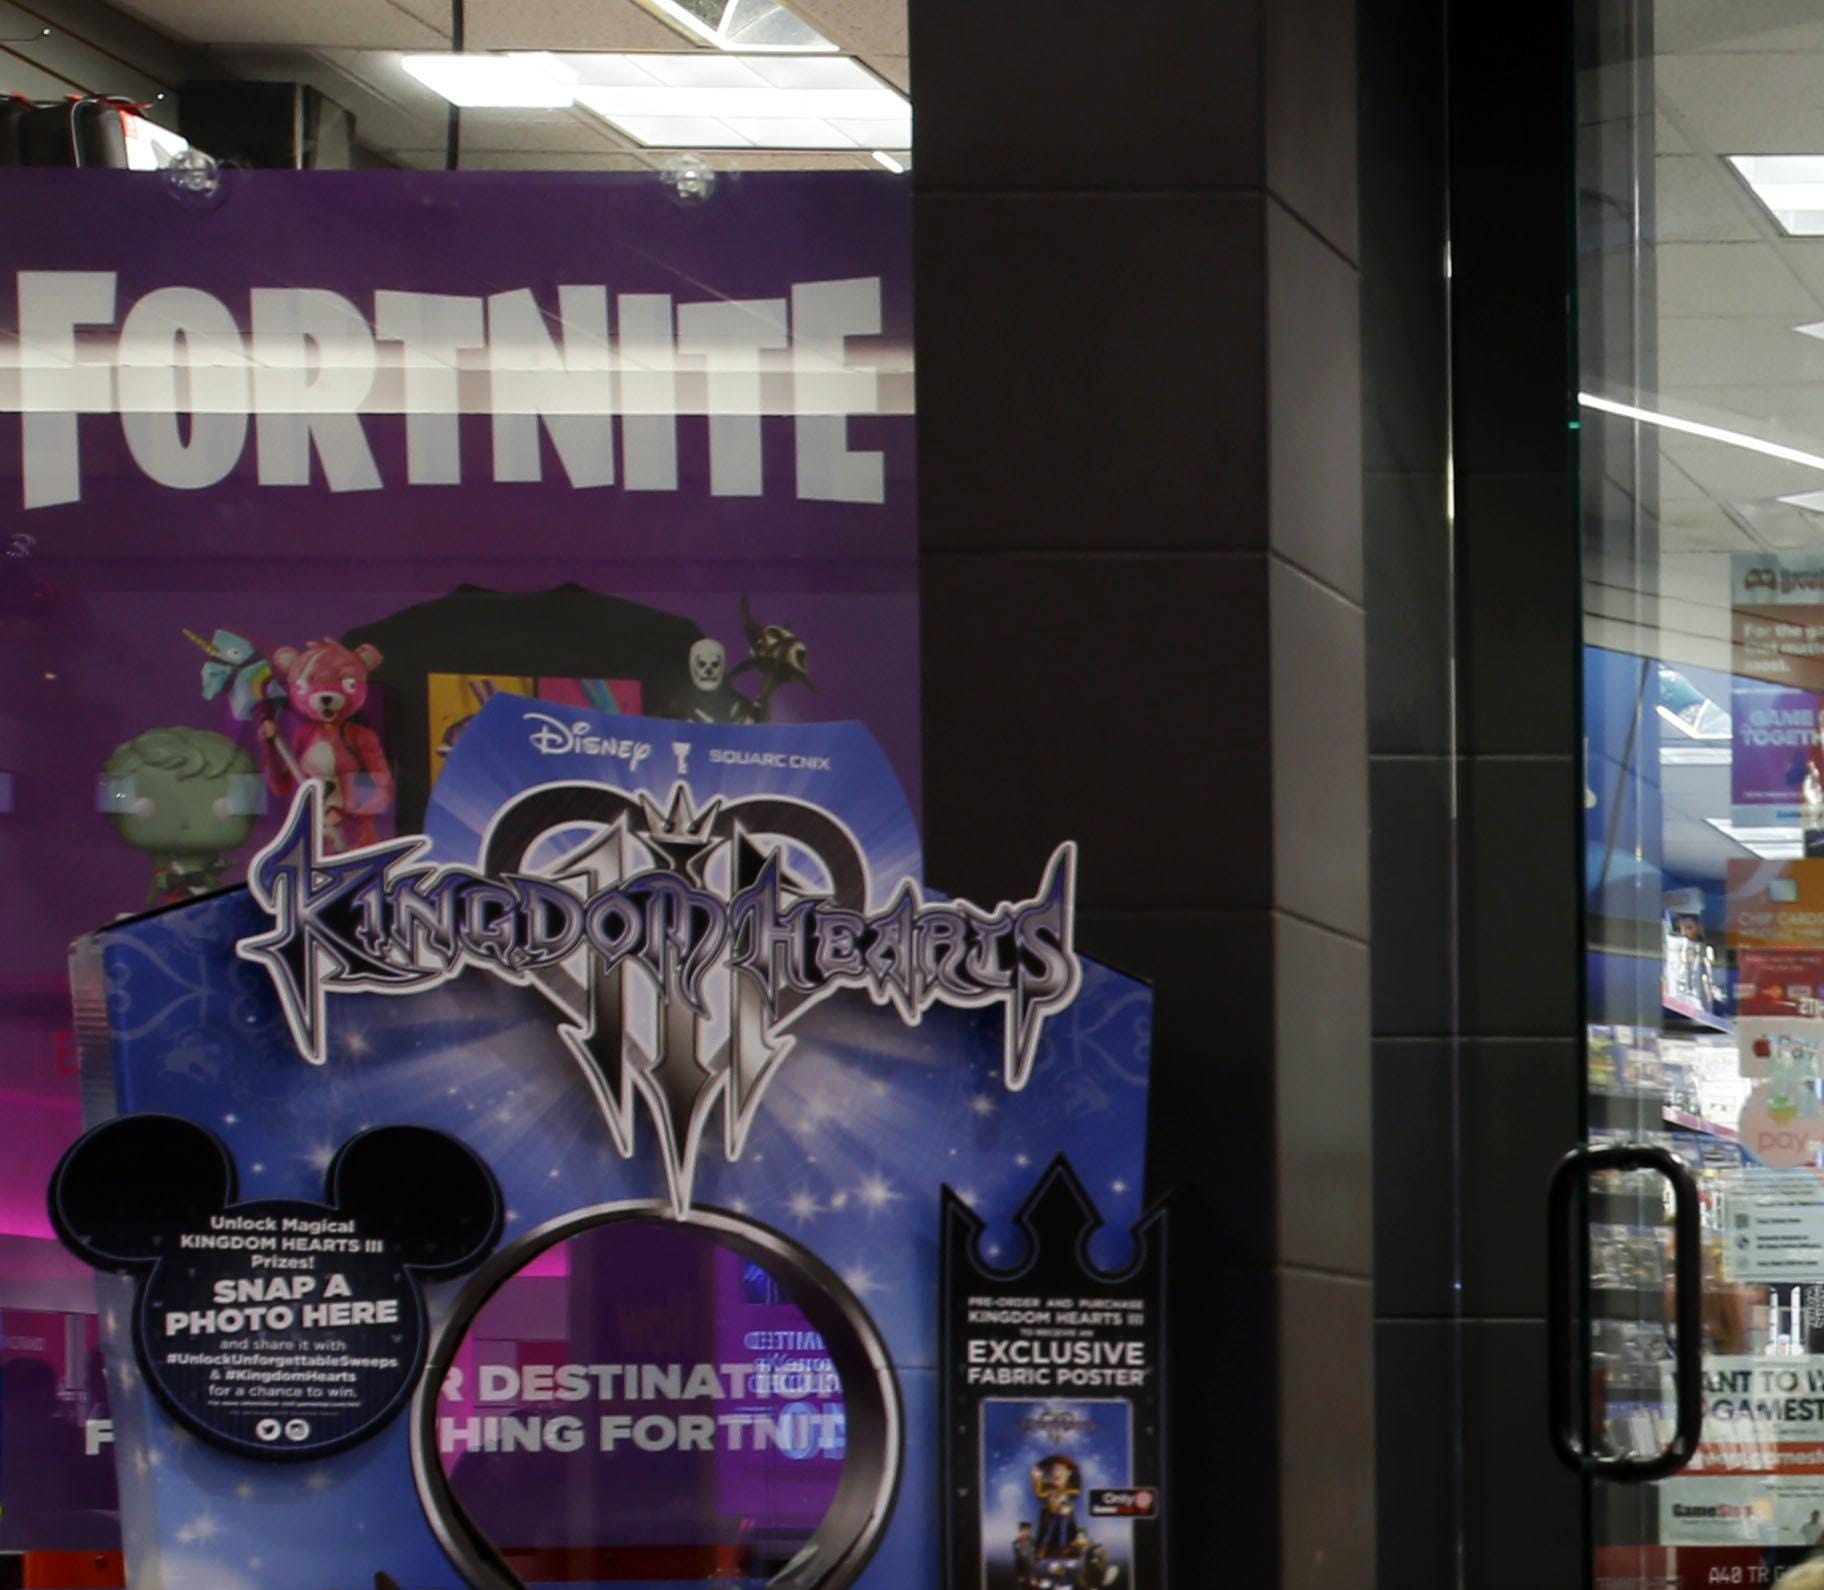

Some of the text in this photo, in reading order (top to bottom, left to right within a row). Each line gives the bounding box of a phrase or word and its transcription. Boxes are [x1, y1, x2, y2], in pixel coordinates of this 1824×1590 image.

[17, 271, 885, 510] FORTNITE
[1749, 709, 1814, 727] GAME
[524, 711, 652, 773] Disney
[238, 781, 1072, 1088] KINGDOM HEARTS
[210, 1216, 355, 1234] Unlock Magical
[180, 1234, 384, 1253] KINGDOM HEARTS III
[251, 1254, 315, 1270] Prizes!
[213, 1273, 353, 1304] SNAP A
[968, 1296, 1143, 1309] PRE-ORDER AND PURCHASE
[165, 1299, 398, 1336] PHOTO HERE
[968, 1310, 1145, 1326] KINGDOM HEARTS III
[219, 1339, 347, 1350] and share it with
[967, 1340, 1145, 1365] EXCLUSIVE
[166, 1353, 398, 1369] #UnlockUnforgettableSweeps
[225, 1369, 357, 1383] #KingdomHearts
[967, 1367, 1146, 1386] FABRIC POSTER
[1760, 1371, 1798, 1392] TO
[208, 1384, 230, 1397] for
[248, 1385, 306, 1397] chance
[307, 1386, 323, 1397] to
[1708, 1567, 1770, 1585] A40 TR
